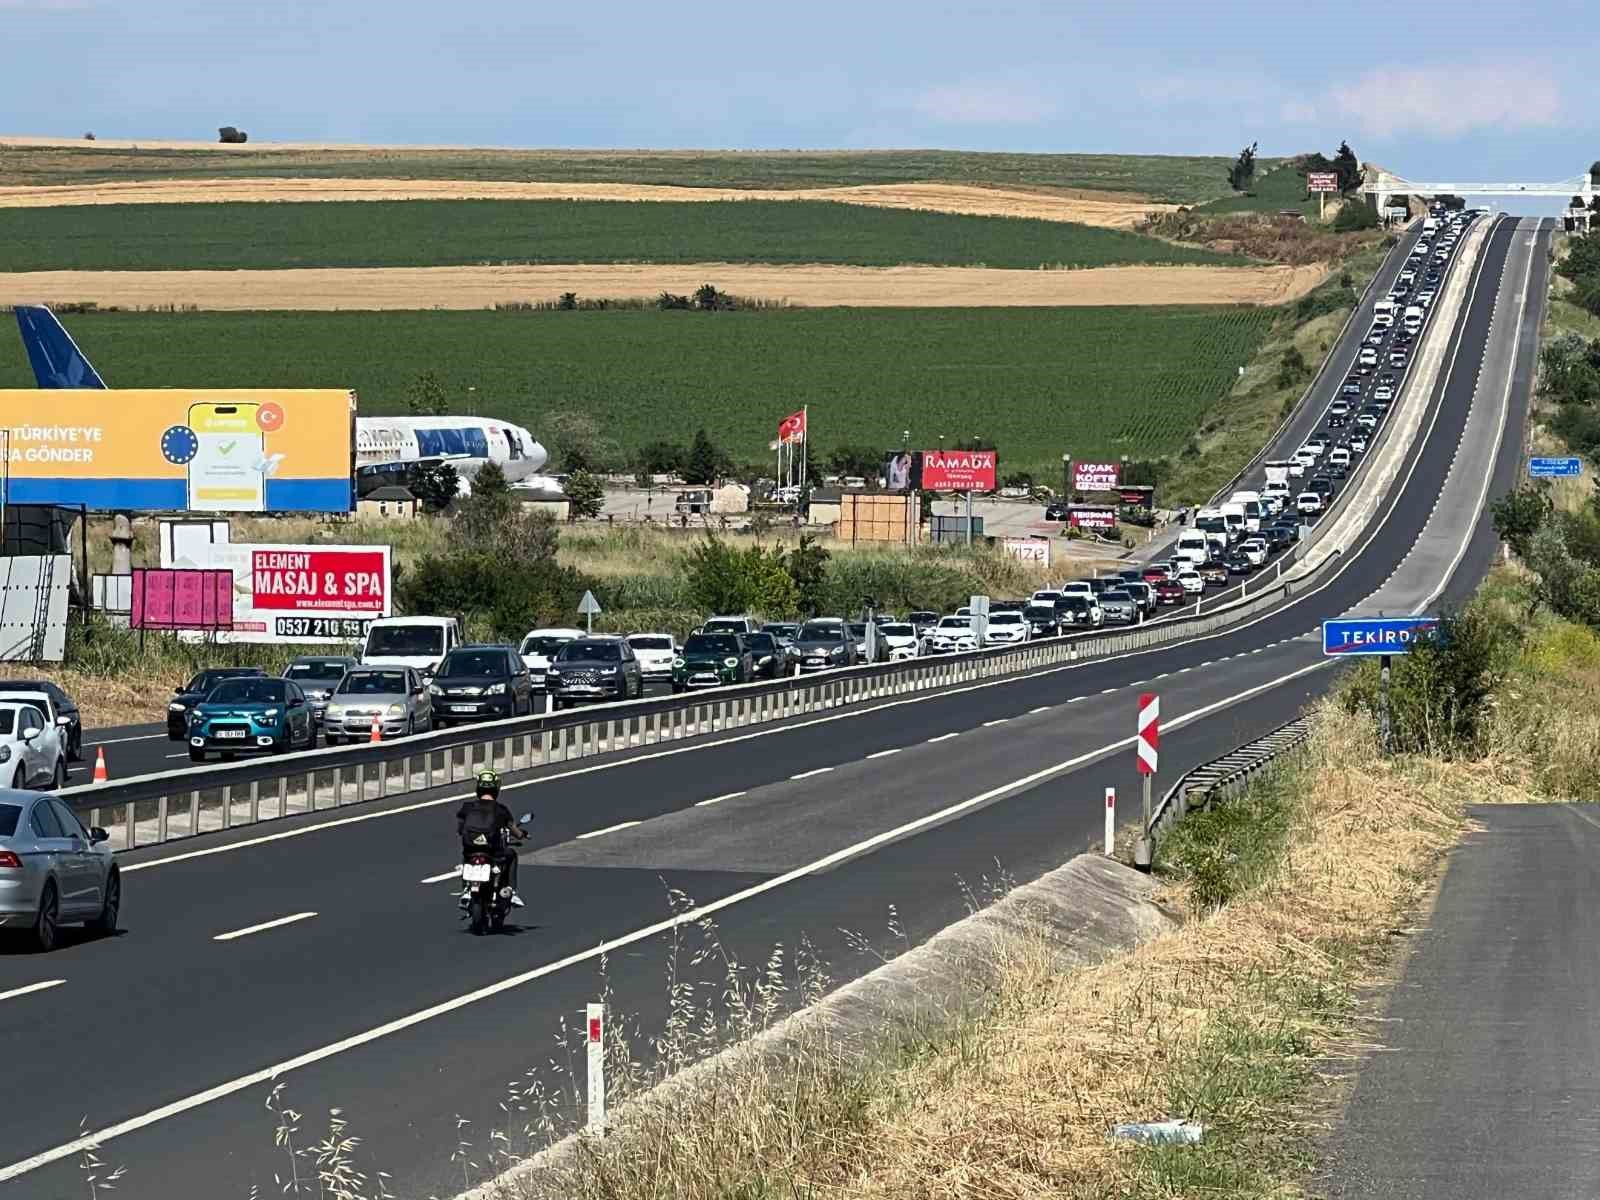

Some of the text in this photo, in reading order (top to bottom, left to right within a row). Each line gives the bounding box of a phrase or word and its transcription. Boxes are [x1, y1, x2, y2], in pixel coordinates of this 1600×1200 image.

[13, 424, 103, 442] TÜRKİYE'YE
[25, 444, 94, 463] GÖNDER
[925, 455, 992, 469] RAMADA
[255, 553, 311, 570] ELEMENT
[255, 570, 382, 596] MASAJ & SPA
[277, 619, 310, 636] 0537
[313, 619, 339, 636] 210
